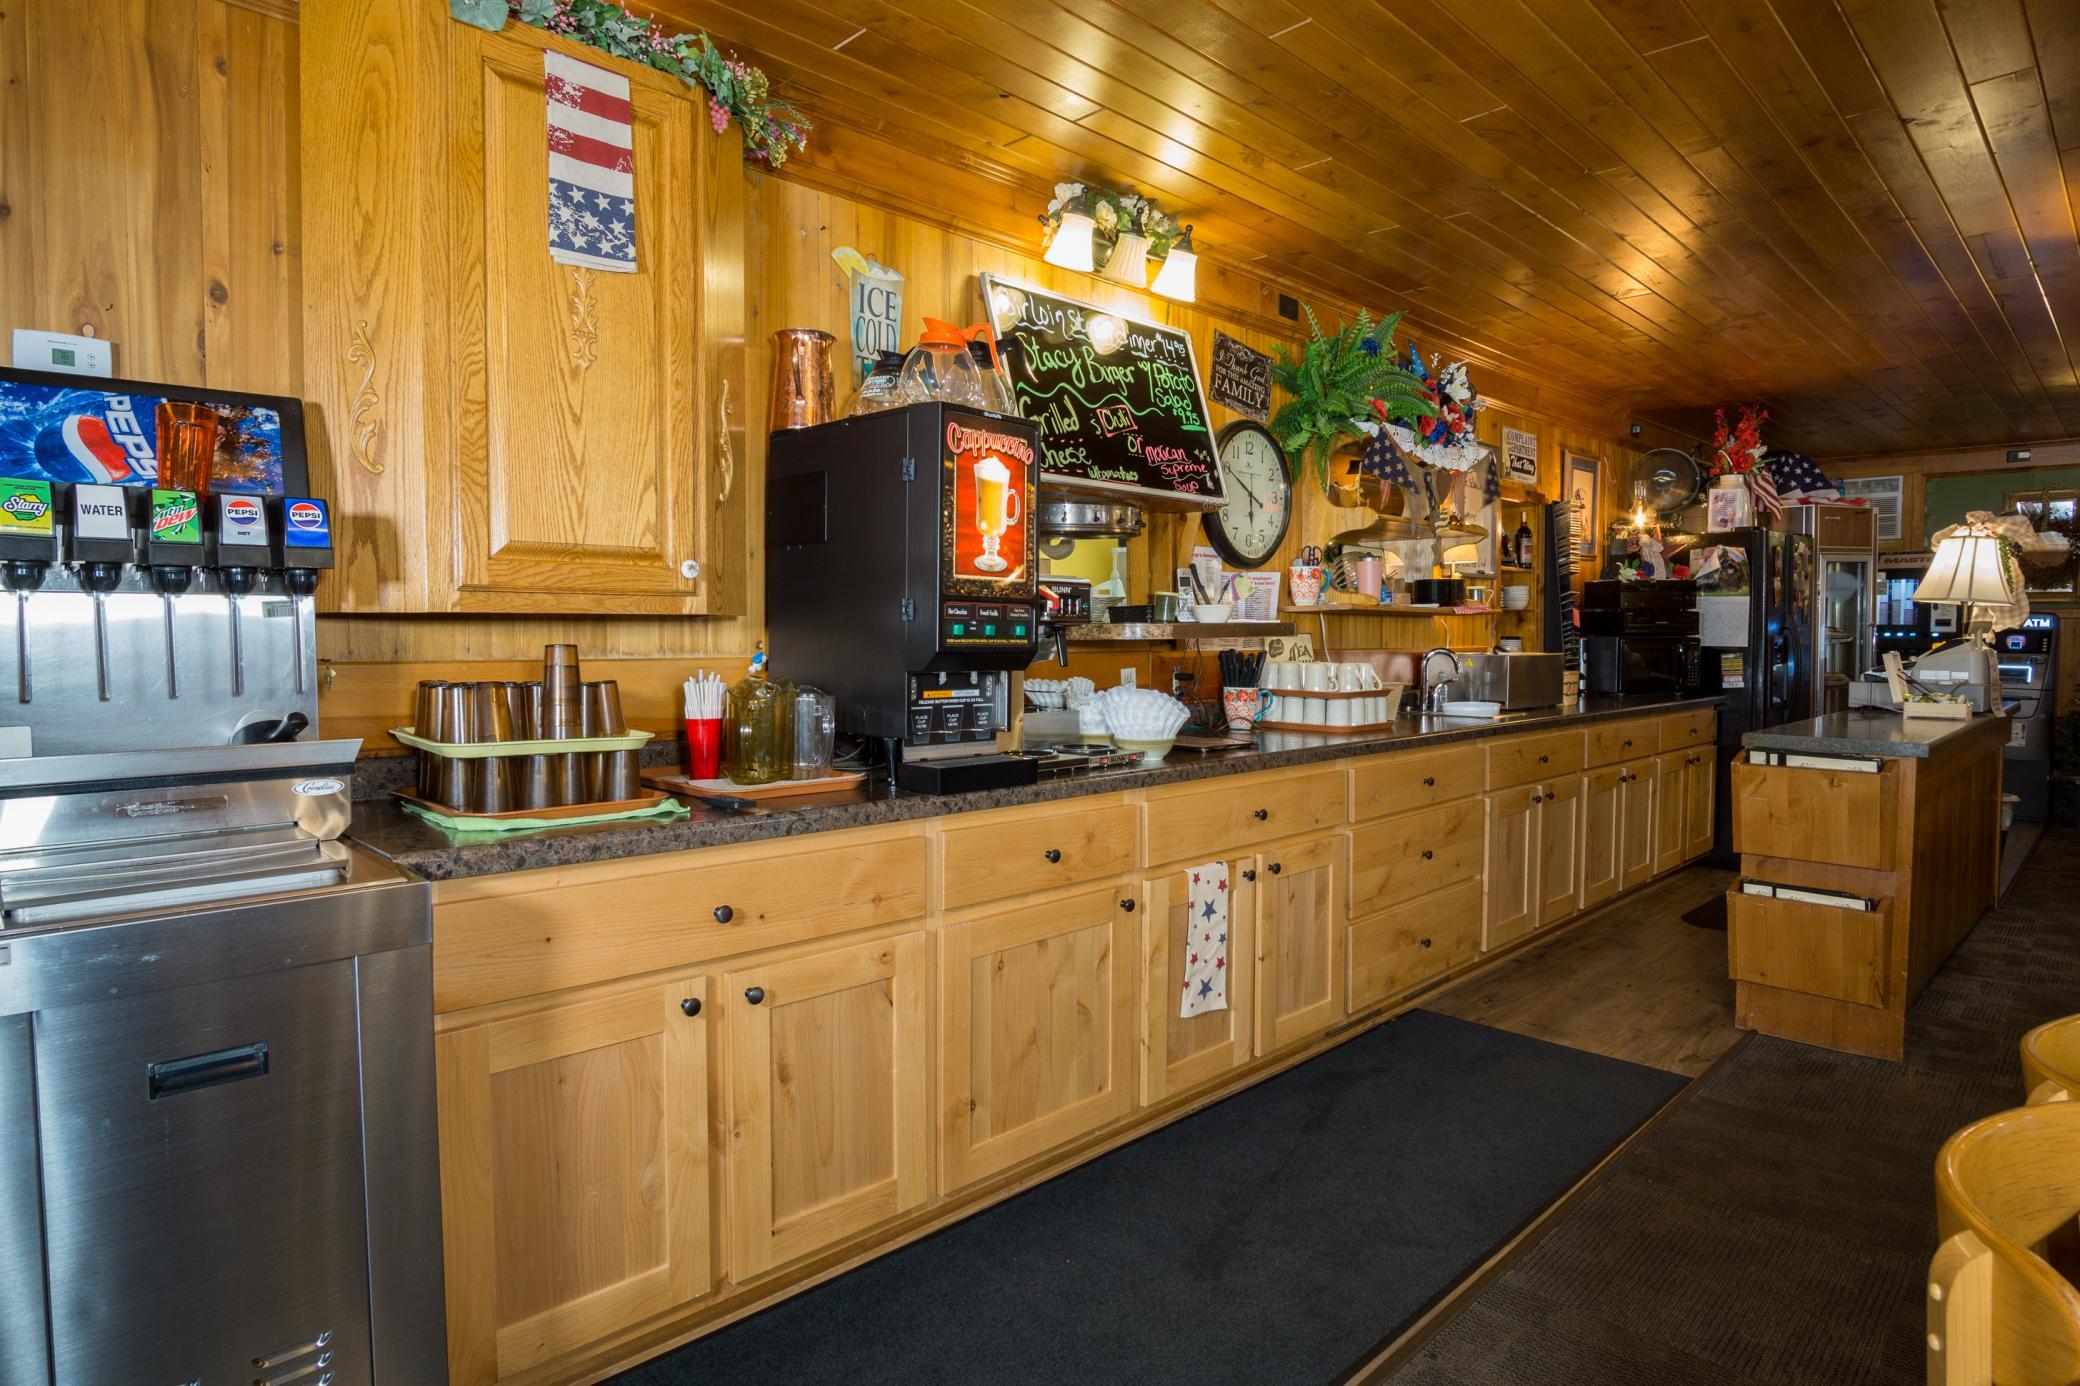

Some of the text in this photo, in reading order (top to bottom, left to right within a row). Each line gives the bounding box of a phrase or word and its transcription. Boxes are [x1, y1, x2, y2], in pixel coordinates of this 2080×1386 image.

[859, 282, 897, 322] ICE
[856, 315, 897, 355] COLD
[1015, 332, 1086, 387] Stacy
[1082, 345, 1135, 396] Burger
[1153, 363, 1195, 392] Potato
[1224, 352, 1248, 374] Thank
[1250, 366, 1267, 383] God
[1215, 365, 1227, 376] FOR
[1228, 370, 1240, 381] THIS
[1214, 372, 1265, 408] FAMILY
[1155, 387, 1192, 411] Salad
[1102, 408, 1131, 430] Chili
[946, 422, 1034, 465] Cappuccino
[1245, 441, 1254, 456] 12
[1232, 445, 1240, 459] 11
[1268, 468, 1275, 482] 2
[1271, 491, 1278, 505] 3
[3, 496, 48, 517] Starry
[80, 503, 123, 517] WATER
[227, 508, 258, 517] PEPSI
[291, 511, 321, 519] PEPSI
[1222, 508, 1229, 523] 8
[1267, 514, 1274, 527] 4
[1232, 527, 1239, 541] 7
[1245, 534, 1252, 548] 6
[1258, 529, 1265, 543] 5
[1051, 586, 1072, 594] BUNN
[2023, 618, 2051, 628] ATM
